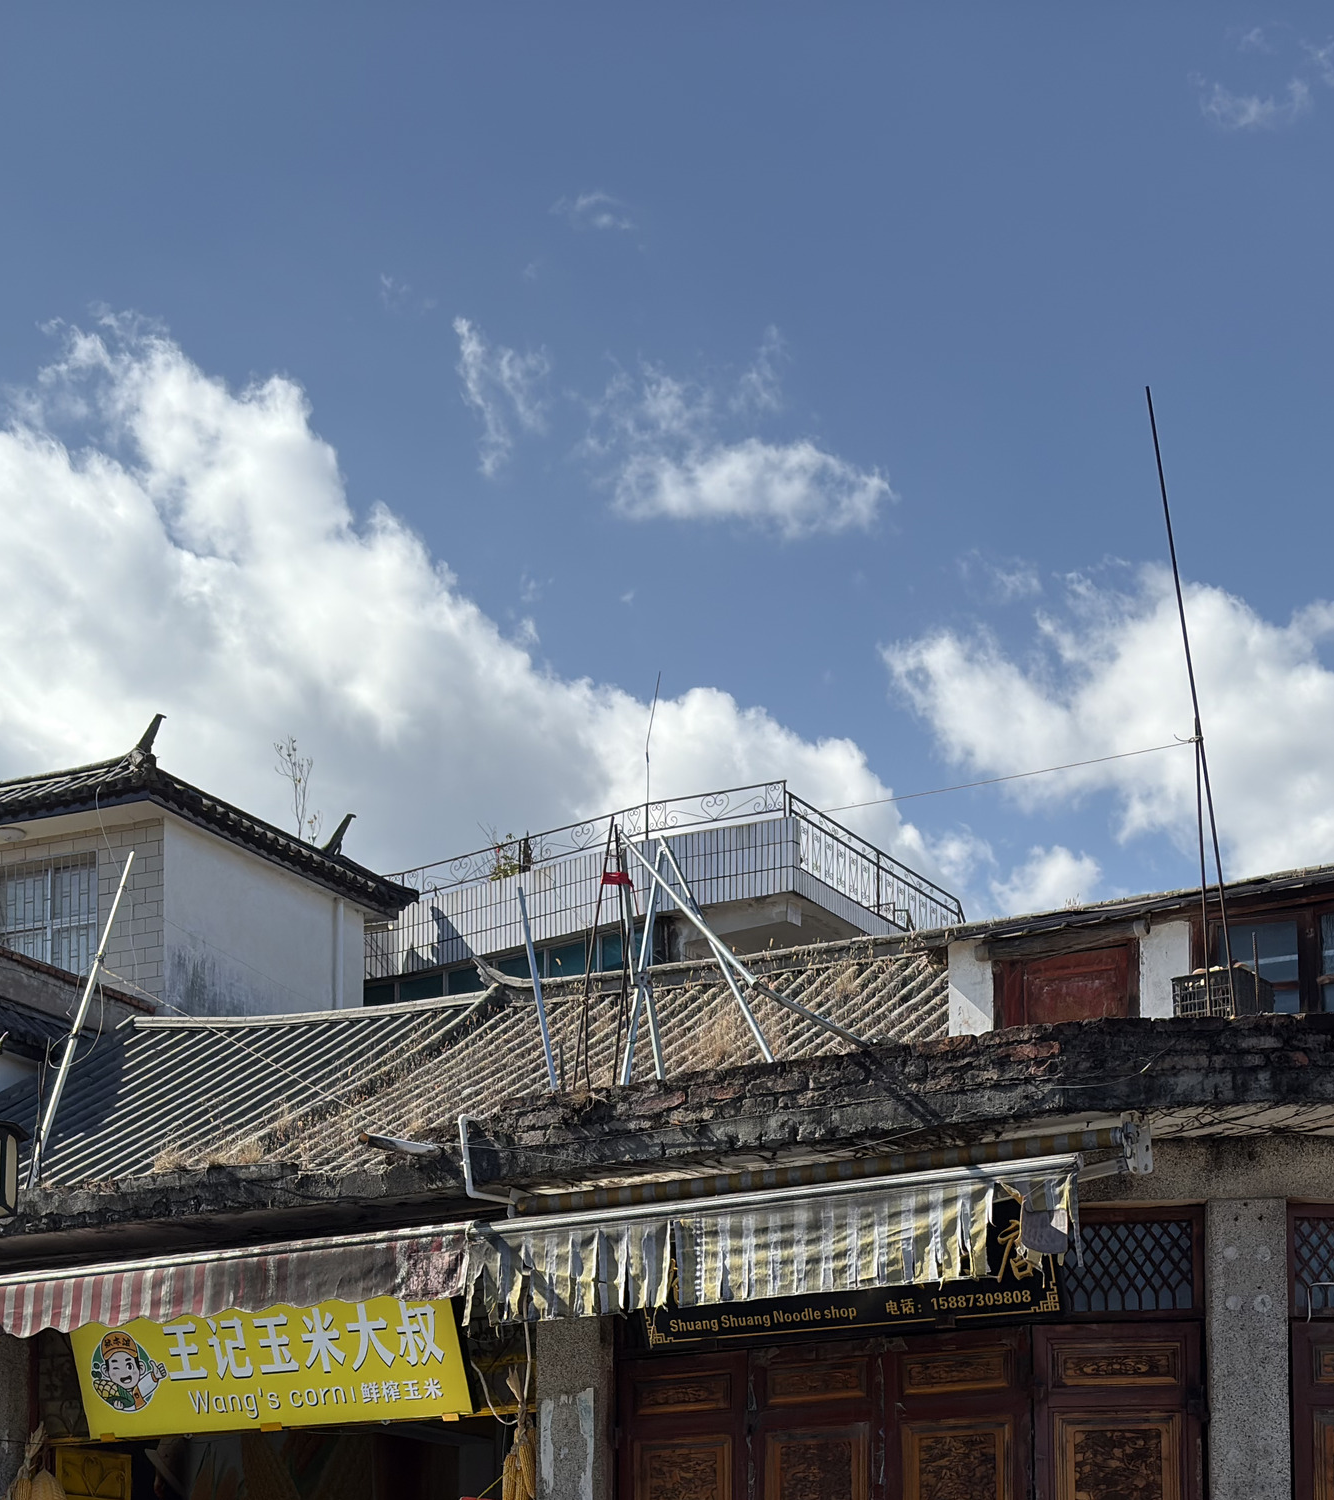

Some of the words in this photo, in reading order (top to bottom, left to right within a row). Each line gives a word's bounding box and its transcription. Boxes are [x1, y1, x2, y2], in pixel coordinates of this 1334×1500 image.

[930, 1289, 1033, 1311] 15887309808
[669, 1317, 719, 1334] Shuang
[720, 1313, 771, 1329] Shuang
[773, 1308, 821, 1324] Noodle
[824, 1306, 857, 1322] shop
[162, 1301, 445, 1380] 王记玉米大叔
[188, 1388, 280, 1419] Wang's
[290, 1384, 351, 1408] corn
[360, 1378, 444, 1405] 鲜榨玉米
